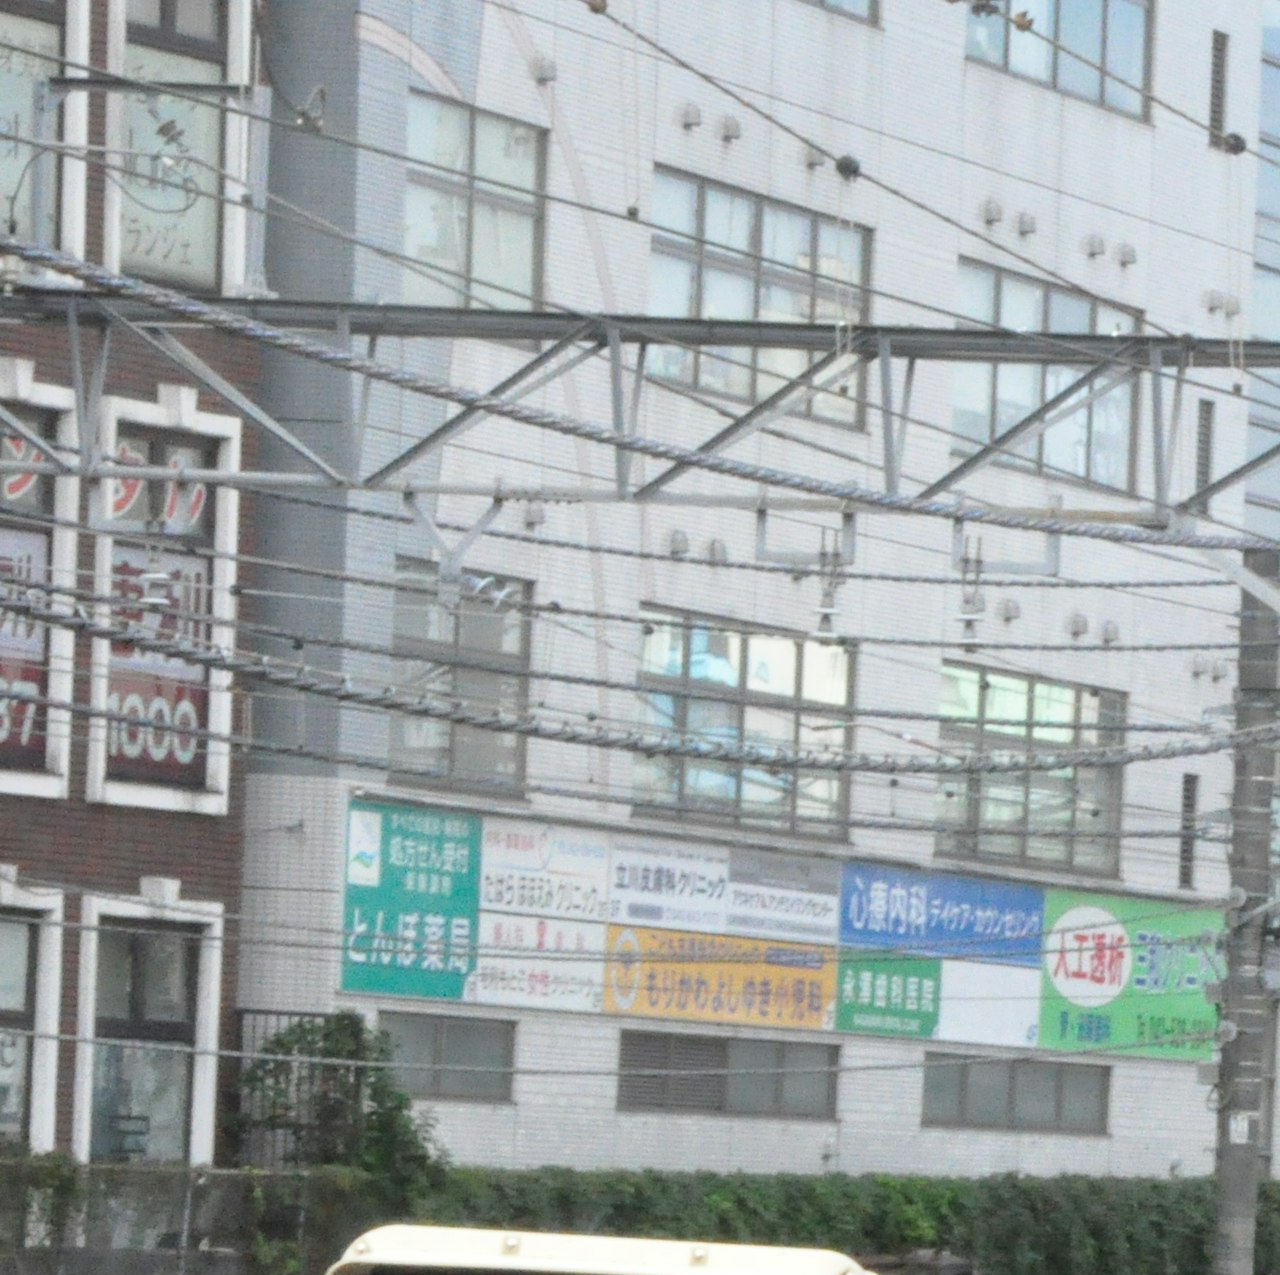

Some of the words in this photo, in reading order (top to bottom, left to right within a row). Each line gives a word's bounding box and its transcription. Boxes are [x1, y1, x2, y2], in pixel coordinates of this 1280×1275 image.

[389, 837, 469, 874] 処方せん受付
[615, 864, 726, 900] 立川皮膚科クリニック
[849, 876, 928, 935] 心療内科
[348, 908, 470, 974] とんぼ薬局
[1054, 931, 1125, 985] 人工透析
